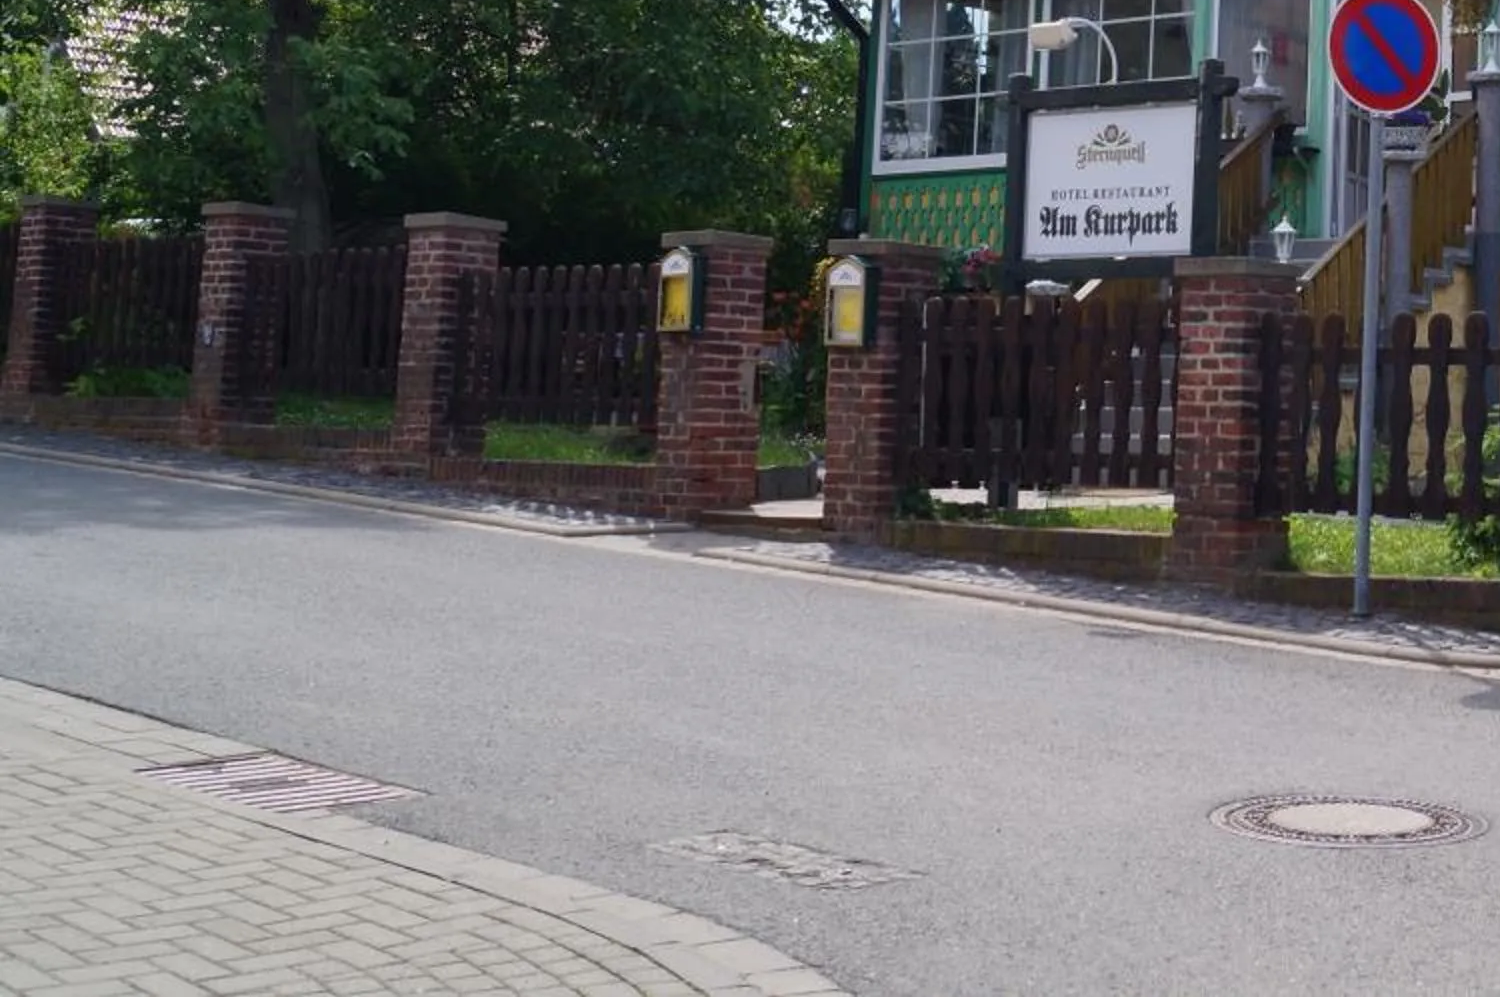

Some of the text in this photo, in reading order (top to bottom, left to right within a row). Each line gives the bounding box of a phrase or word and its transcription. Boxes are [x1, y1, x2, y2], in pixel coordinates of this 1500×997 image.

[1051, 186, 1170, 200] HOTEL RESTAURANT
[1040, 202, 1178, 246] Am Kurpark
